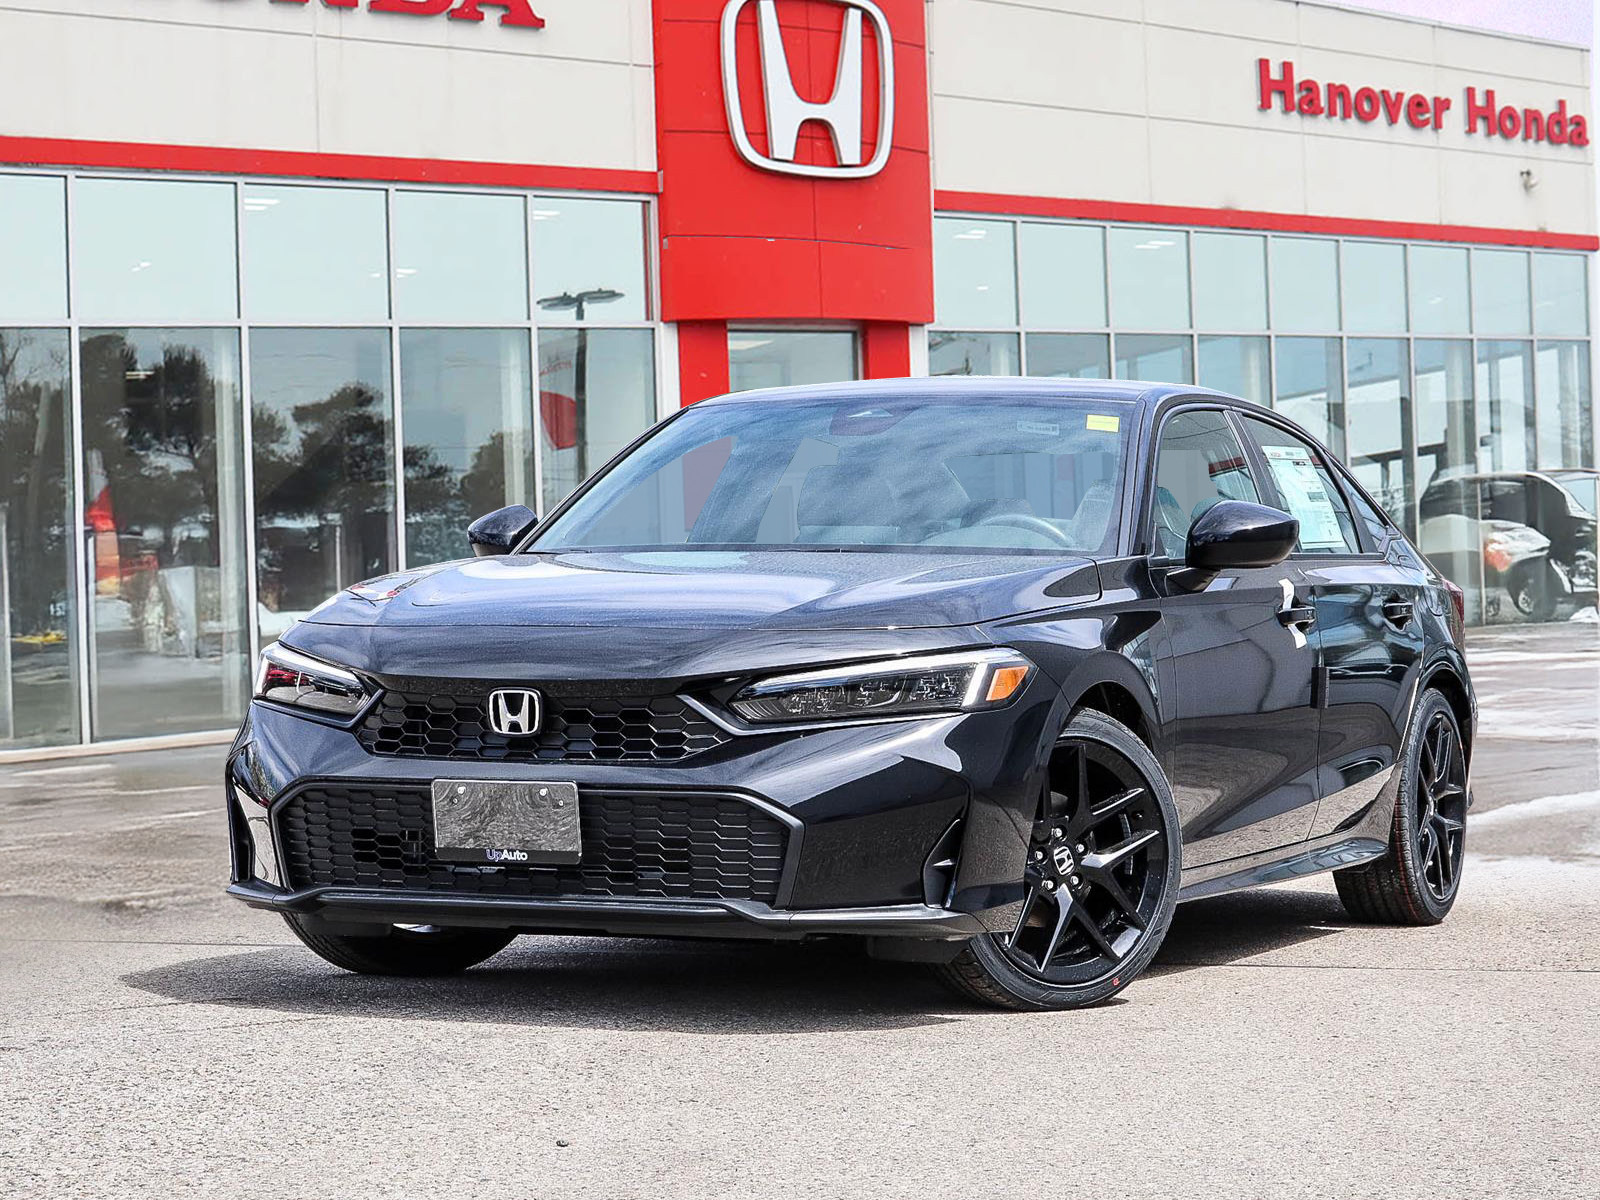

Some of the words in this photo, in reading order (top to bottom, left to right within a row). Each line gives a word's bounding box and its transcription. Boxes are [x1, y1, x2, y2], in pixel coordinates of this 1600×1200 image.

[1257, 58, 1452, 130] Hanover
[1464, 86, 1590, 147] Honda
[485, 848, 529, 862] UpAuto
